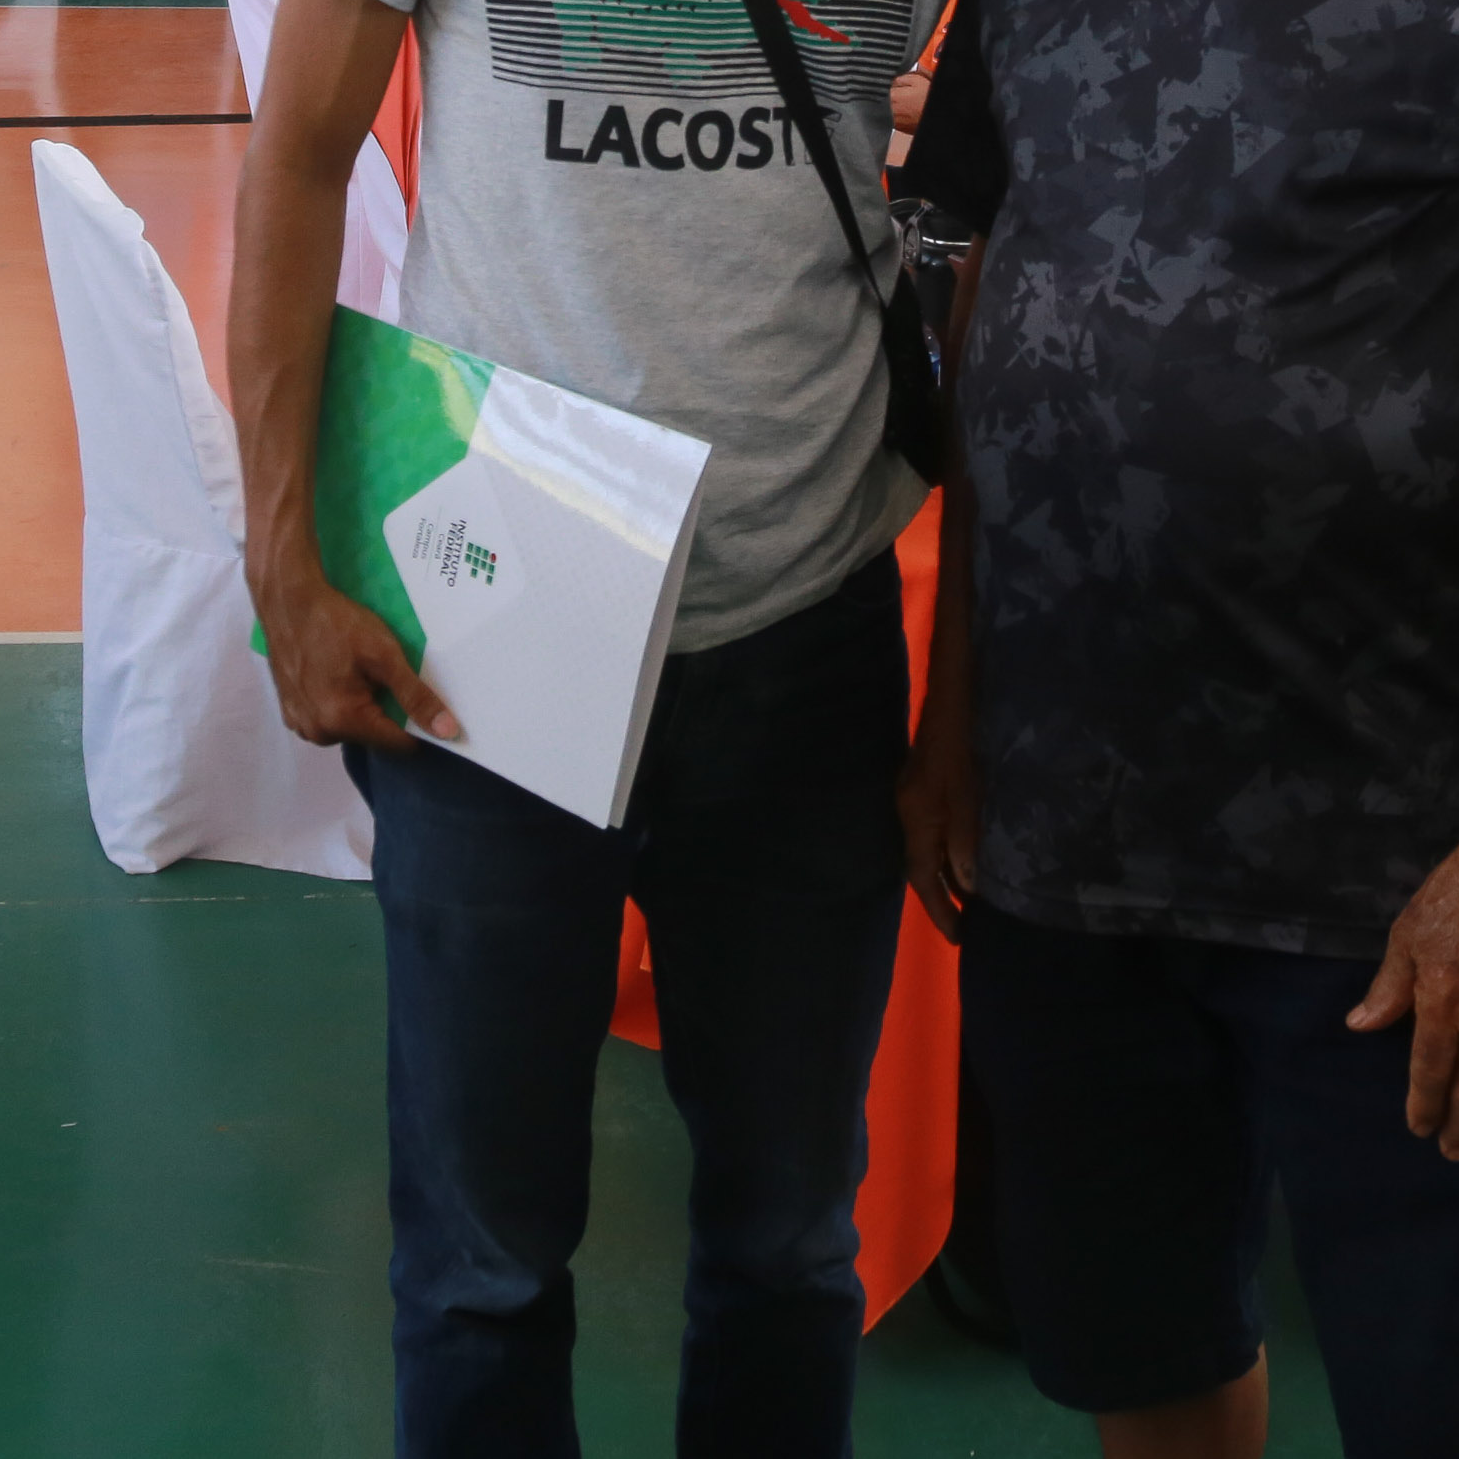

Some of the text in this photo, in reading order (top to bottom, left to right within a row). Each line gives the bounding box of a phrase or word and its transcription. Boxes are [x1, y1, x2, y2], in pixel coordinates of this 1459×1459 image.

[546, 100, 841, 171] LACOST
[440, 522, 458, 577] FEDERAL
[447, 519, 467, 588] INSTITUTO
